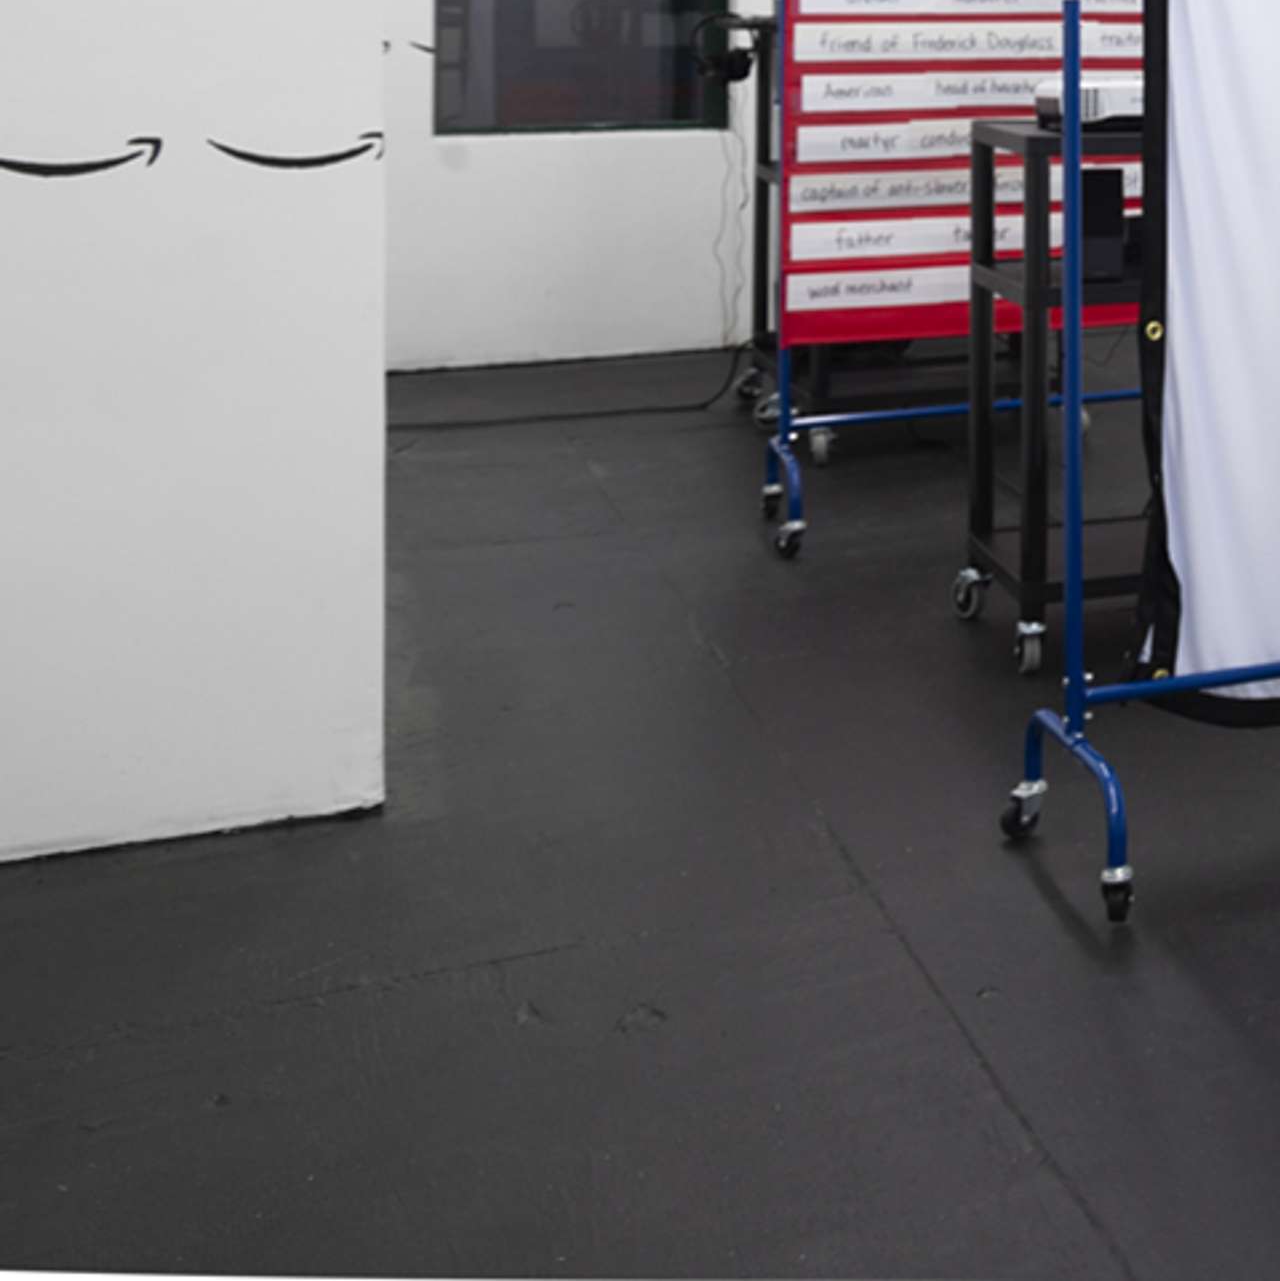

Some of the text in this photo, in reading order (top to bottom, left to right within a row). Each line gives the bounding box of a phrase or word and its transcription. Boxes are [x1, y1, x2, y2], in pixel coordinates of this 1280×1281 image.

[819, 30, 1055, 53] friend of Frederick Douglass
[834, 227, 893, 250] father
